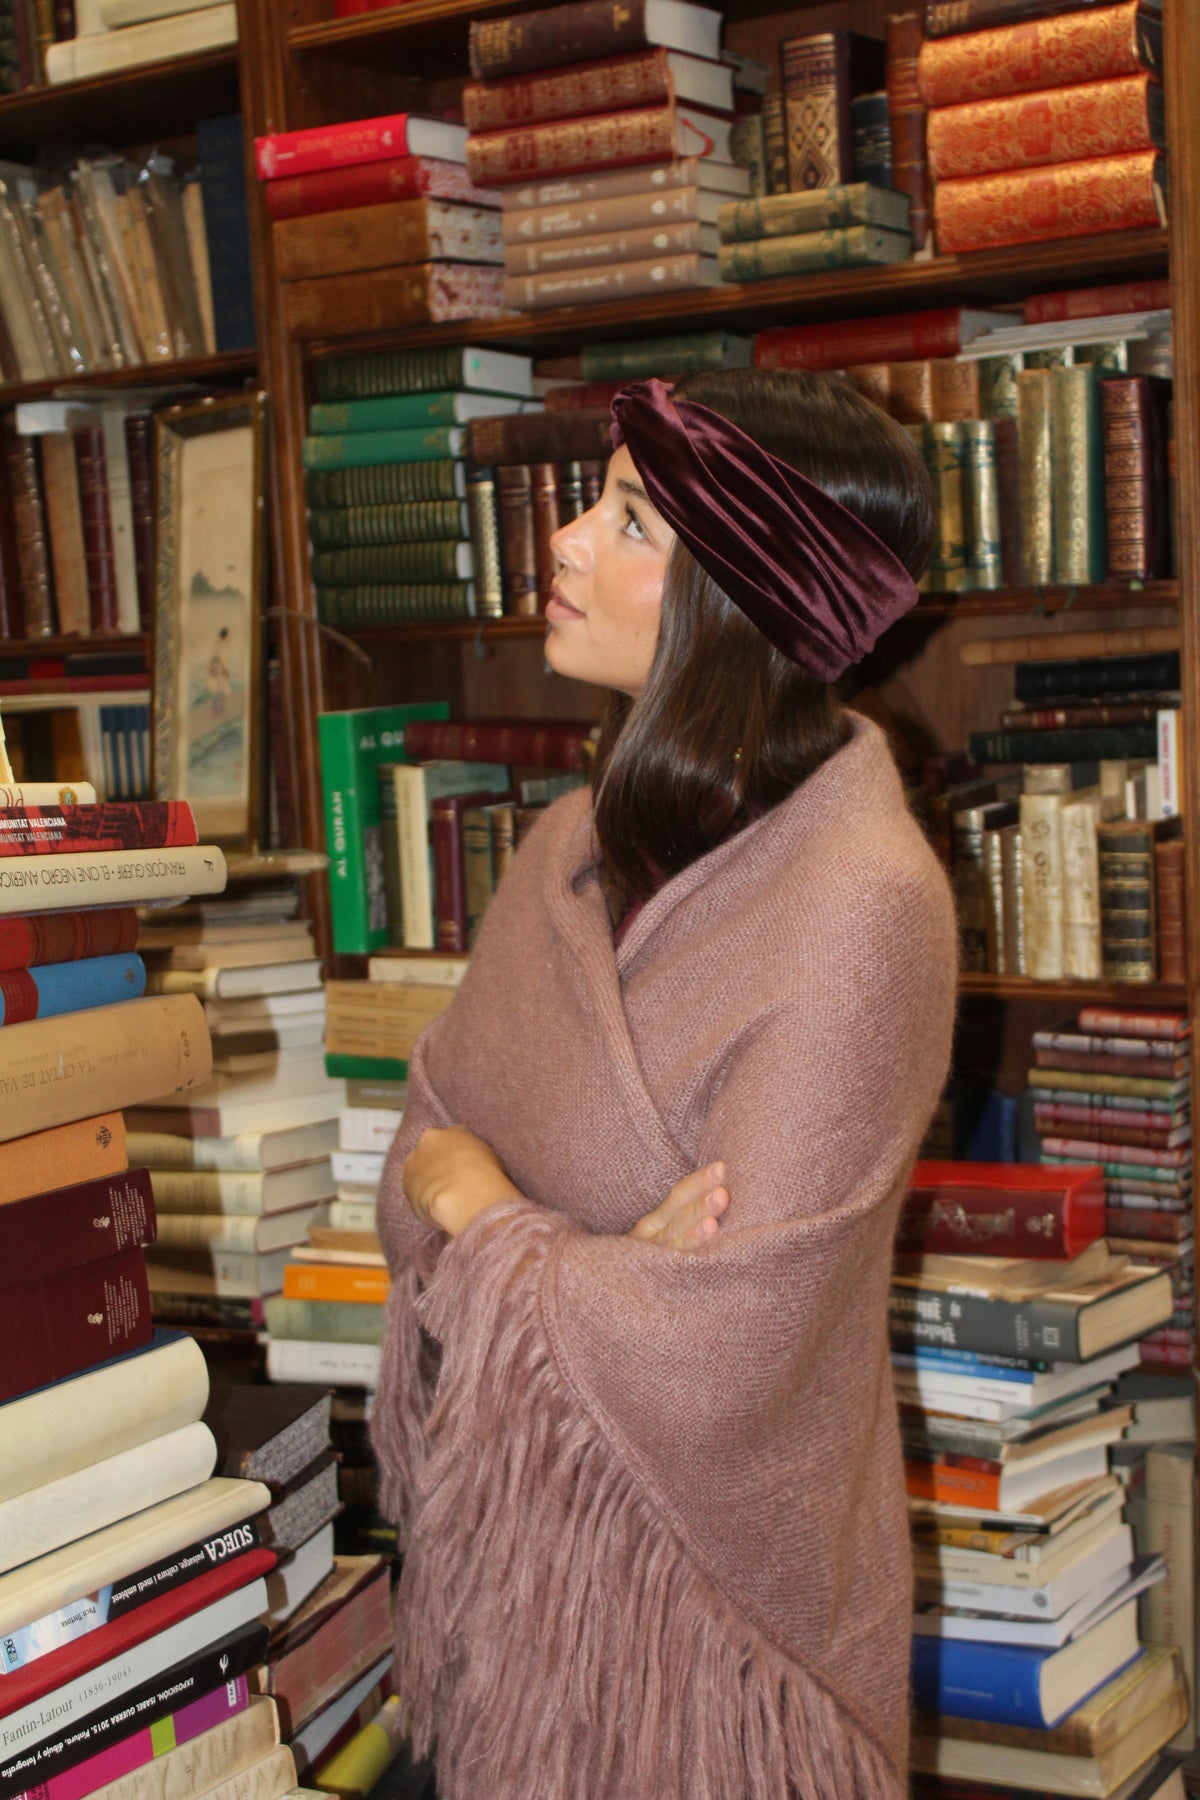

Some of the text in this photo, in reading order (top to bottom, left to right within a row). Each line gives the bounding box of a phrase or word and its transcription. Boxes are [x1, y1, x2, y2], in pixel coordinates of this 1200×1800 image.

[29, 816, 67, 828] VALENCIANA
[41, 867, 76, 887] NEGRO
[77, 865, 98, 883] CINE
[100, 865, 111, 881] EL
[21, 1072, 36, 1089] DE
[203, 1524, 254, 1562] SUECA
[157, 1565, 179, 1581] cultura
[137, 1576, 153, 1592] medi
[111, 1584, 137, 1604] ambient
[60, 1605, 97, 1628] Paco Tortosa
[2, 1666, 132, 1746] Fantin-Latour (1836-1904)
[136, 1695, 156, 1712] ISABEL
[110, 1706, 136, 1725] GUERRA
[42, 1741, 64, 1757] dibujo
